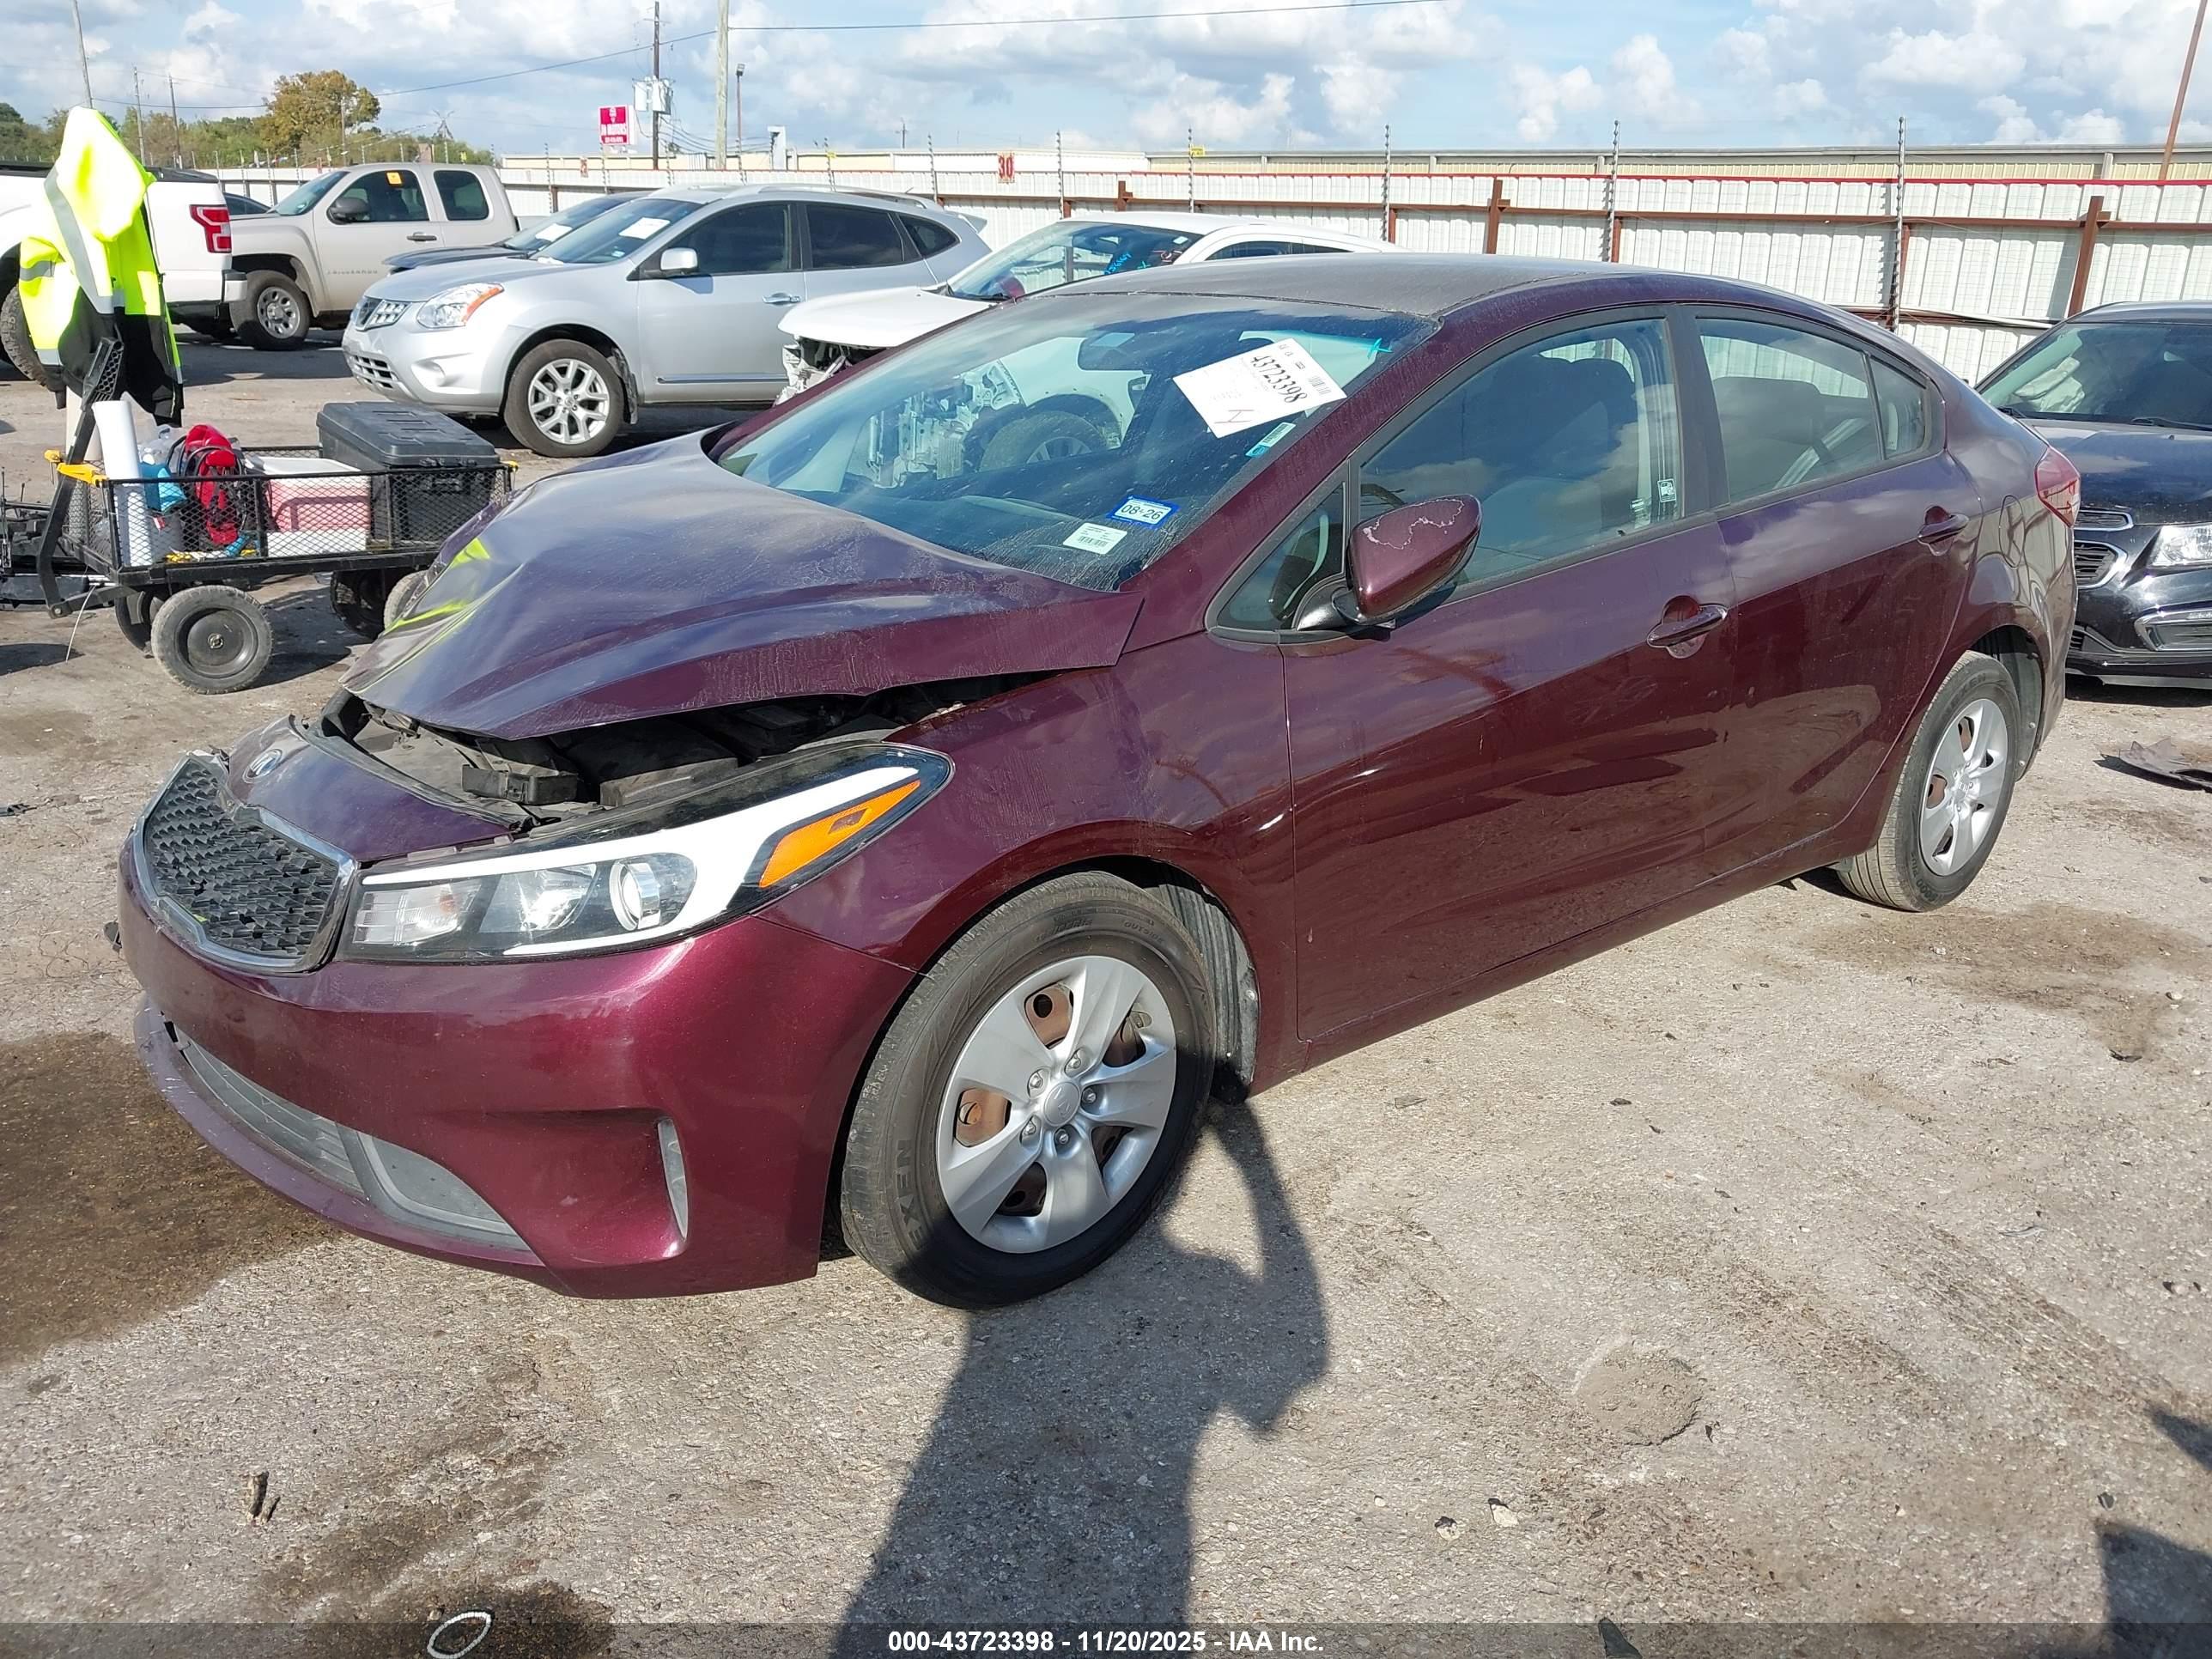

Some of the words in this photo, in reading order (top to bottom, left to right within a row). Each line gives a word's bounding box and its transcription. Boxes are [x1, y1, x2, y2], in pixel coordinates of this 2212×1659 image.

[998, 155, 1014, 179] 30
[1250, 356, 1308, 404] 43723398
[1120, 504, 1141, 515] 08
[1142, 509, 1164, 520] 26
[895, 1139, 927, 1255] EXEN
